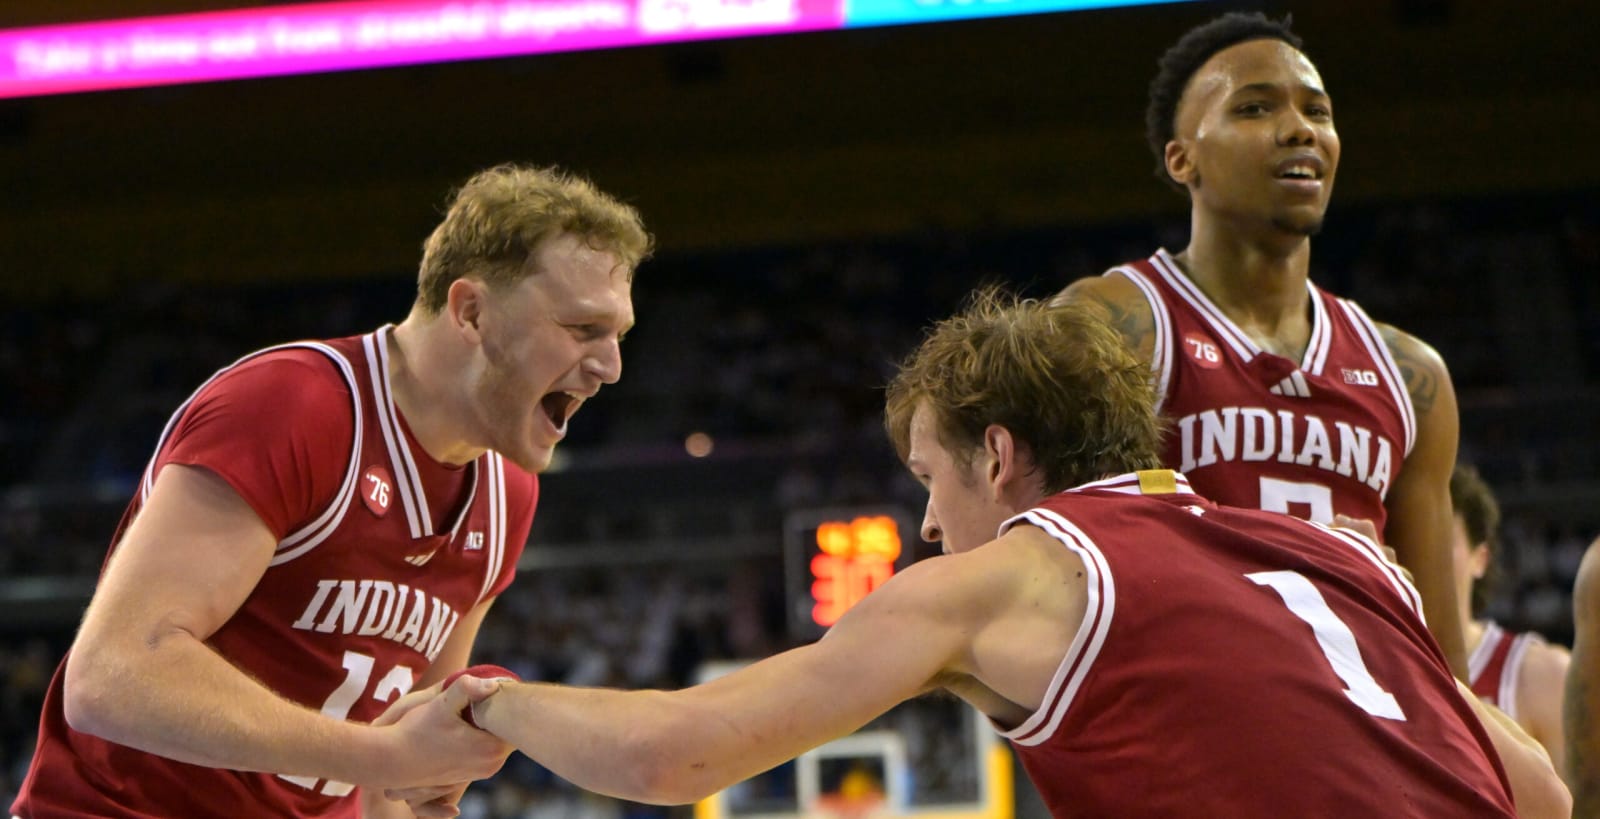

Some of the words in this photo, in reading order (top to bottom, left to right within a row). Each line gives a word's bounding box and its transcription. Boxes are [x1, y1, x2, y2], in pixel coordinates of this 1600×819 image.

[366, 473, 390, 508] '76
[1178, 407, 1391, 501] INDIANA
[1244, 570, 1406, 721] 1
